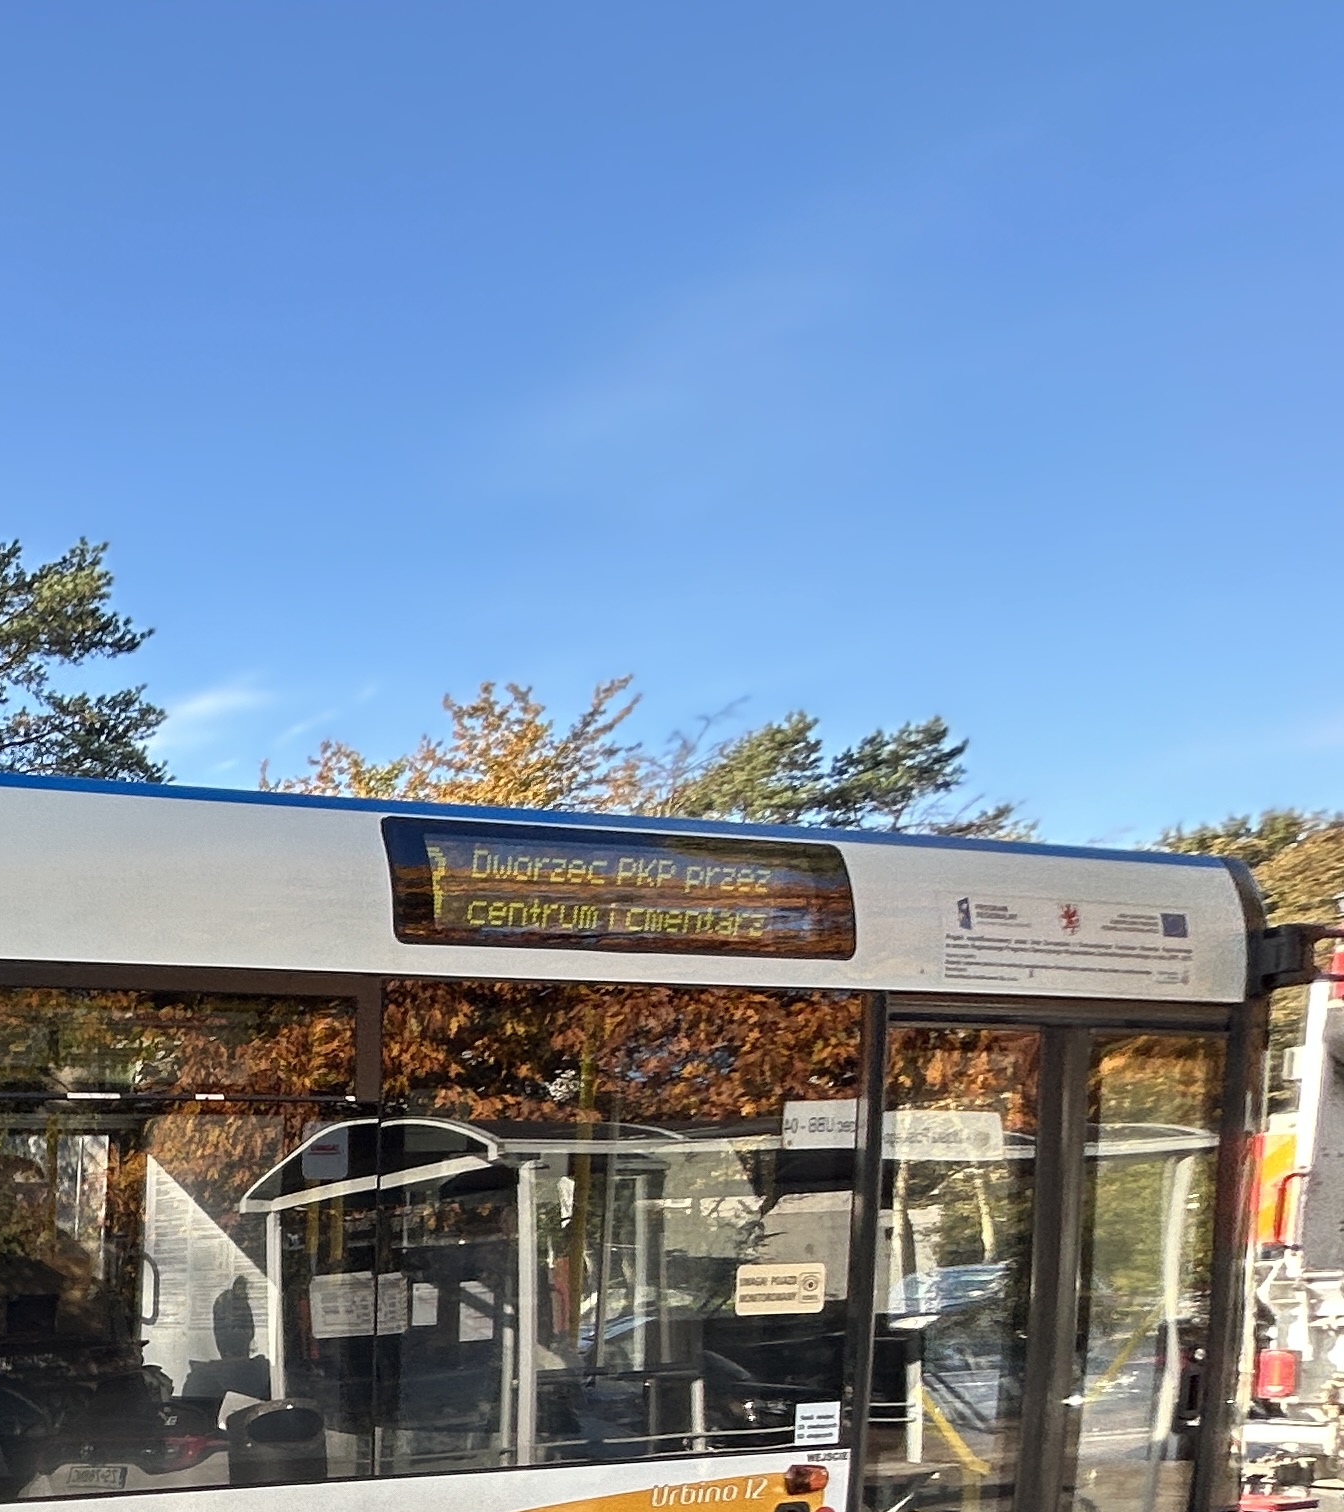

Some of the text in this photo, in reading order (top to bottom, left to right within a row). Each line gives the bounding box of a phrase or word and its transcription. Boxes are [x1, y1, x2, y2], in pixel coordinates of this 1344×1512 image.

[471, 849, 608, 885] Dworzec
[616, 857, 677, 888] PKP
[683, 865, 773, 893] przez
[467, 899, 768, 937] centrum i cmentarz
[651, 1477, 768, 1507] Urbino 12
